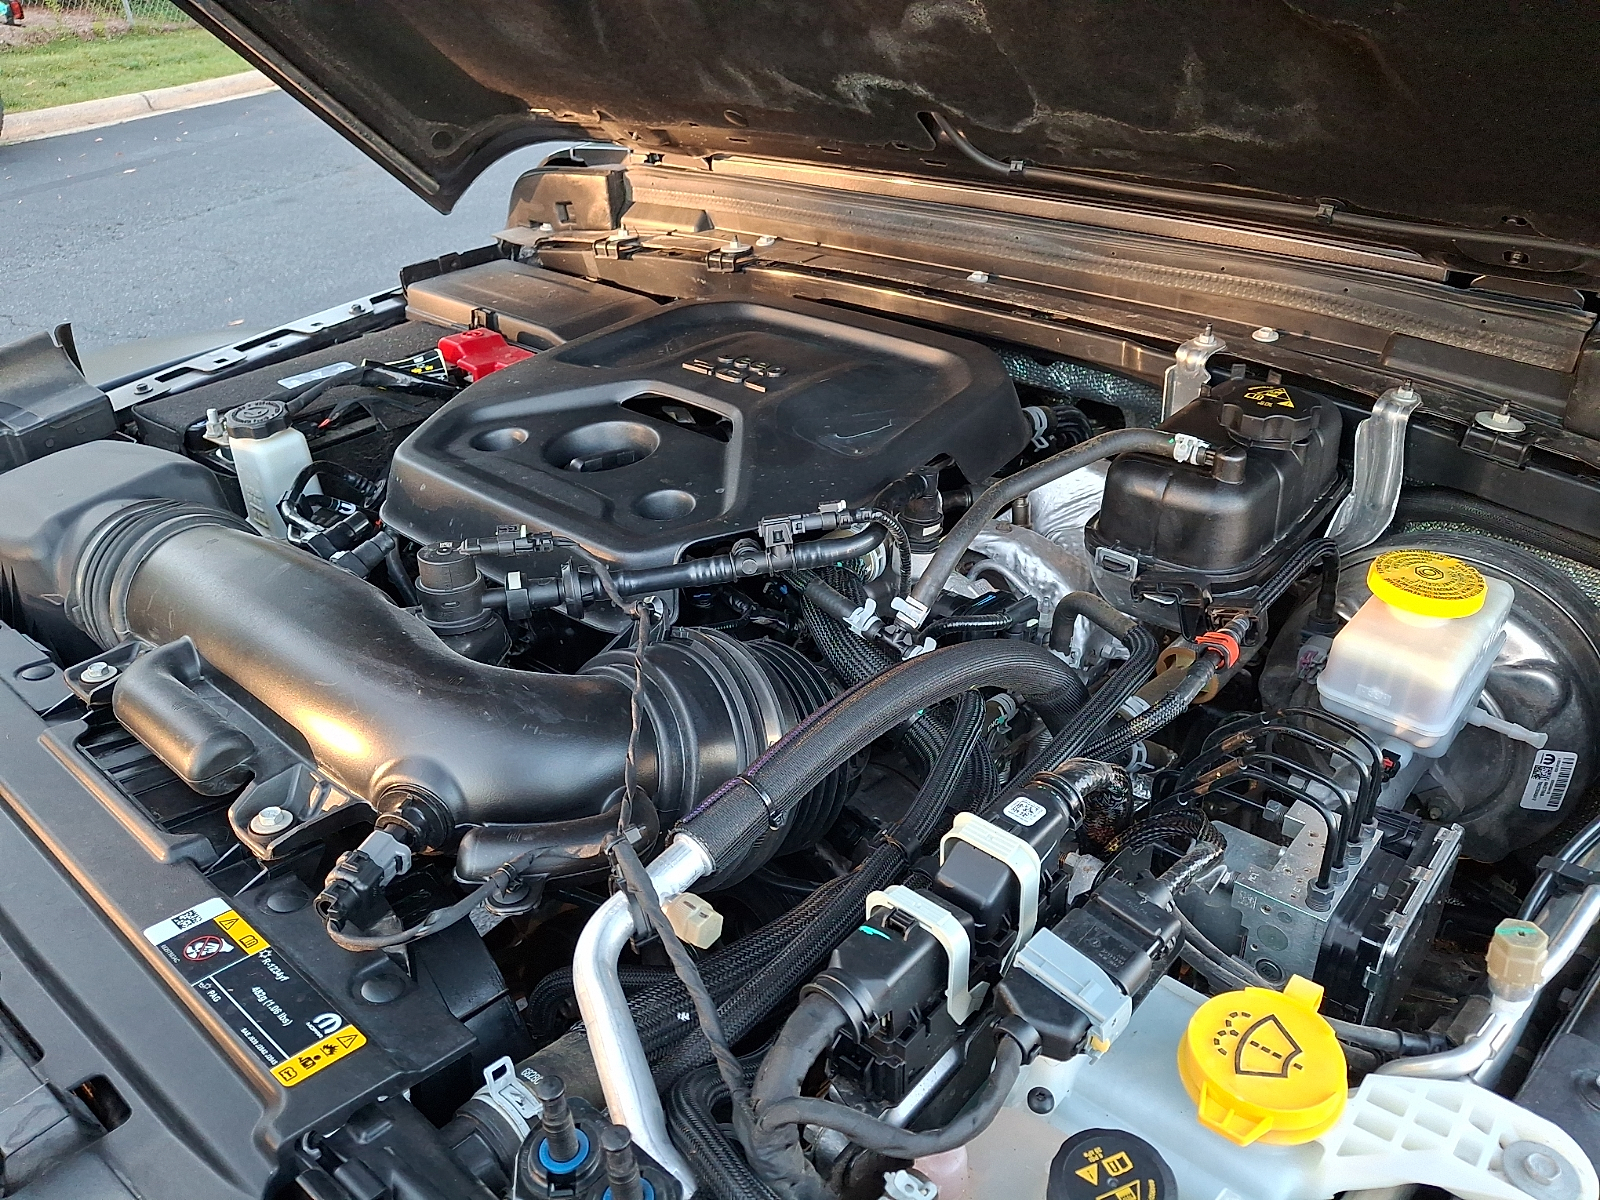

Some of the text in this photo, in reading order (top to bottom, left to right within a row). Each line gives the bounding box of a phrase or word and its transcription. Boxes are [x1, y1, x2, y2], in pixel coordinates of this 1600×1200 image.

[261, 957, 290, 982] R-1234yf
[206, 989, 222, 1003] PAG
[251, 986, 294, 1027] 482g (1.06 lbs)
